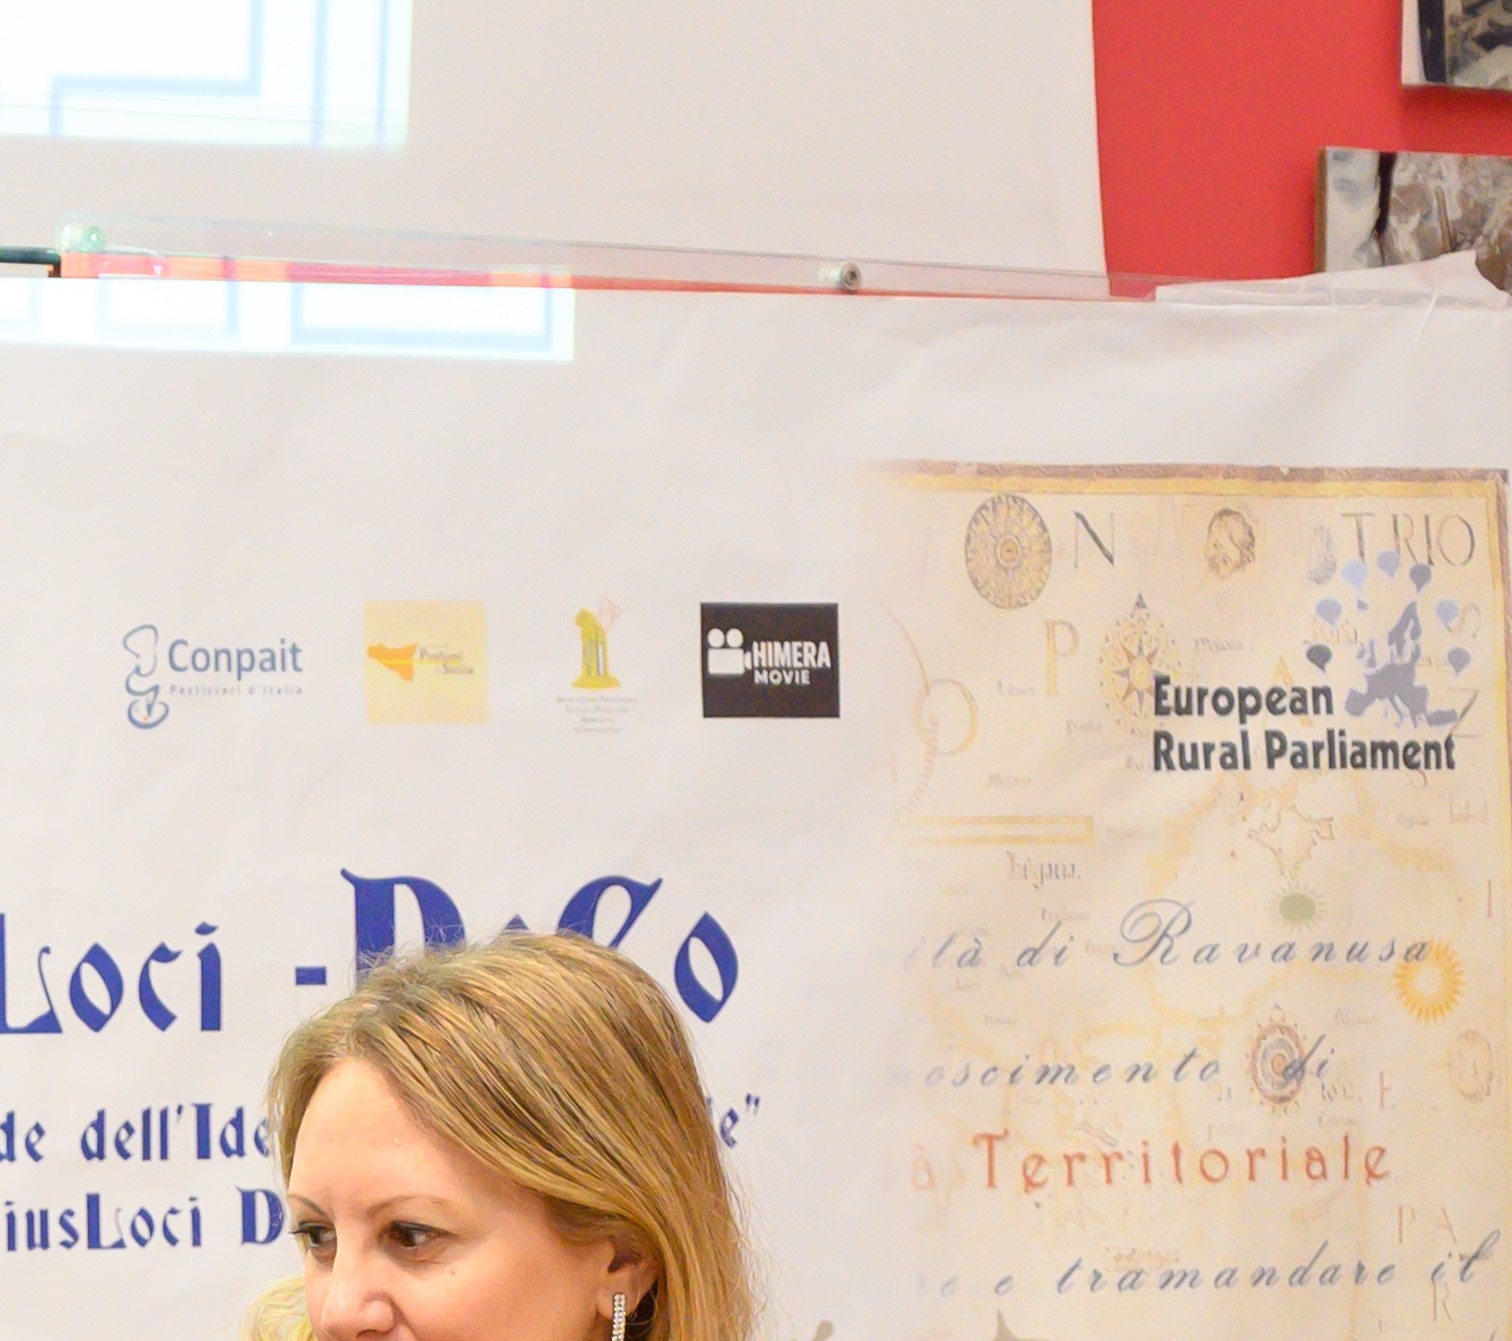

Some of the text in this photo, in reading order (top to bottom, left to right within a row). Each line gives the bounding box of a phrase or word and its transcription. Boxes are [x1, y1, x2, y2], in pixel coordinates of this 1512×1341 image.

[167, 638, 304, 681] Conpait
[753, 669, 812, 686] MOVIE
[1152, 675, 1334, 724] European
[1152, 730, 1457, 774] Rural Parliament
[1016, 897, 1429, 969] di Ravanusa
[1283, 1033, 1337, 1086] di
[79, 1100, 273, 1165] dell'Ide
[972, 1128, 1394, 1195] Territoriale
[1055, 1230, 1501, 1298] tramandare il
